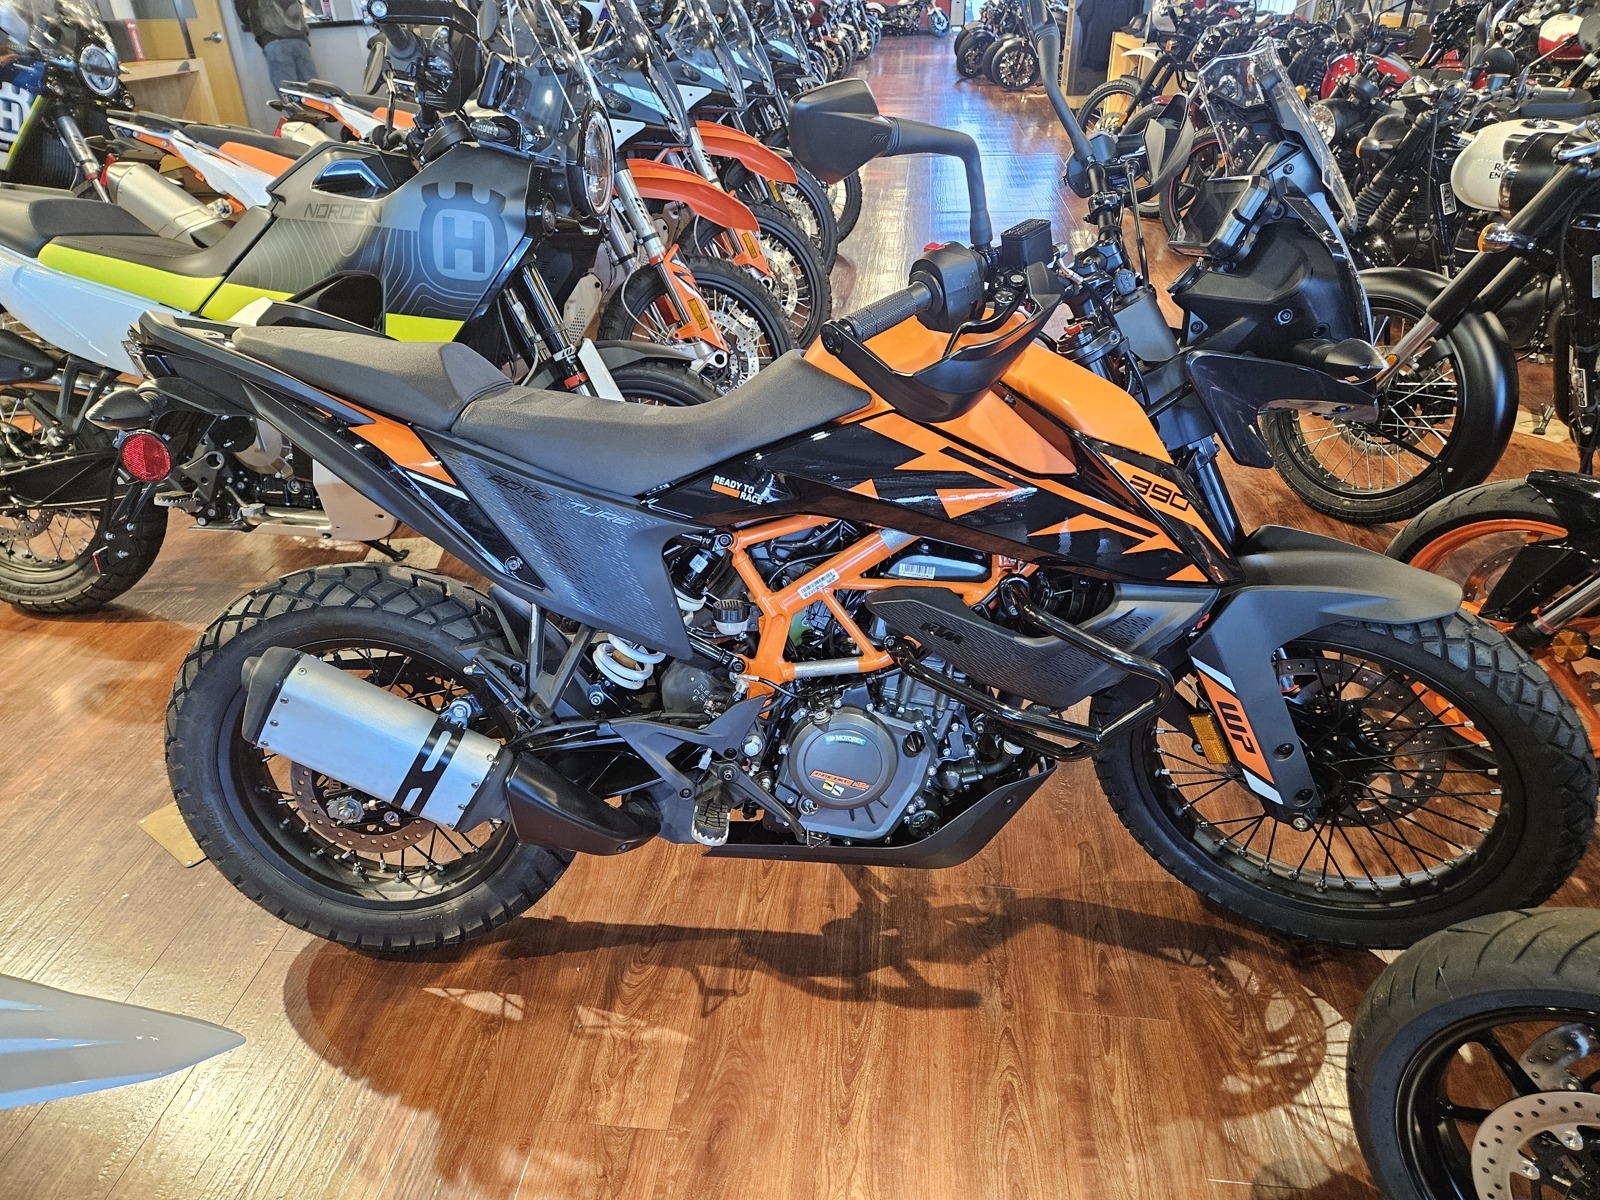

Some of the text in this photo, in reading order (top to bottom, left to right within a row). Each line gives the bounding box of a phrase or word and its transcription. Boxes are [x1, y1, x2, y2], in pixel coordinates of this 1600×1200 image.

[304, 203, 382, 223] NORDEN
[713, 475, 755, 494] READY TO
[1129, 474, 1191, 512] 390
[486, 474, 636, 527] ADVENTURE
[740, 492, 763, 505] RACE
[919, 622, 964, 646] KTM
[1216, 700, 1257, 755] WP
[835, 734, 867, 746] MOTOREX
